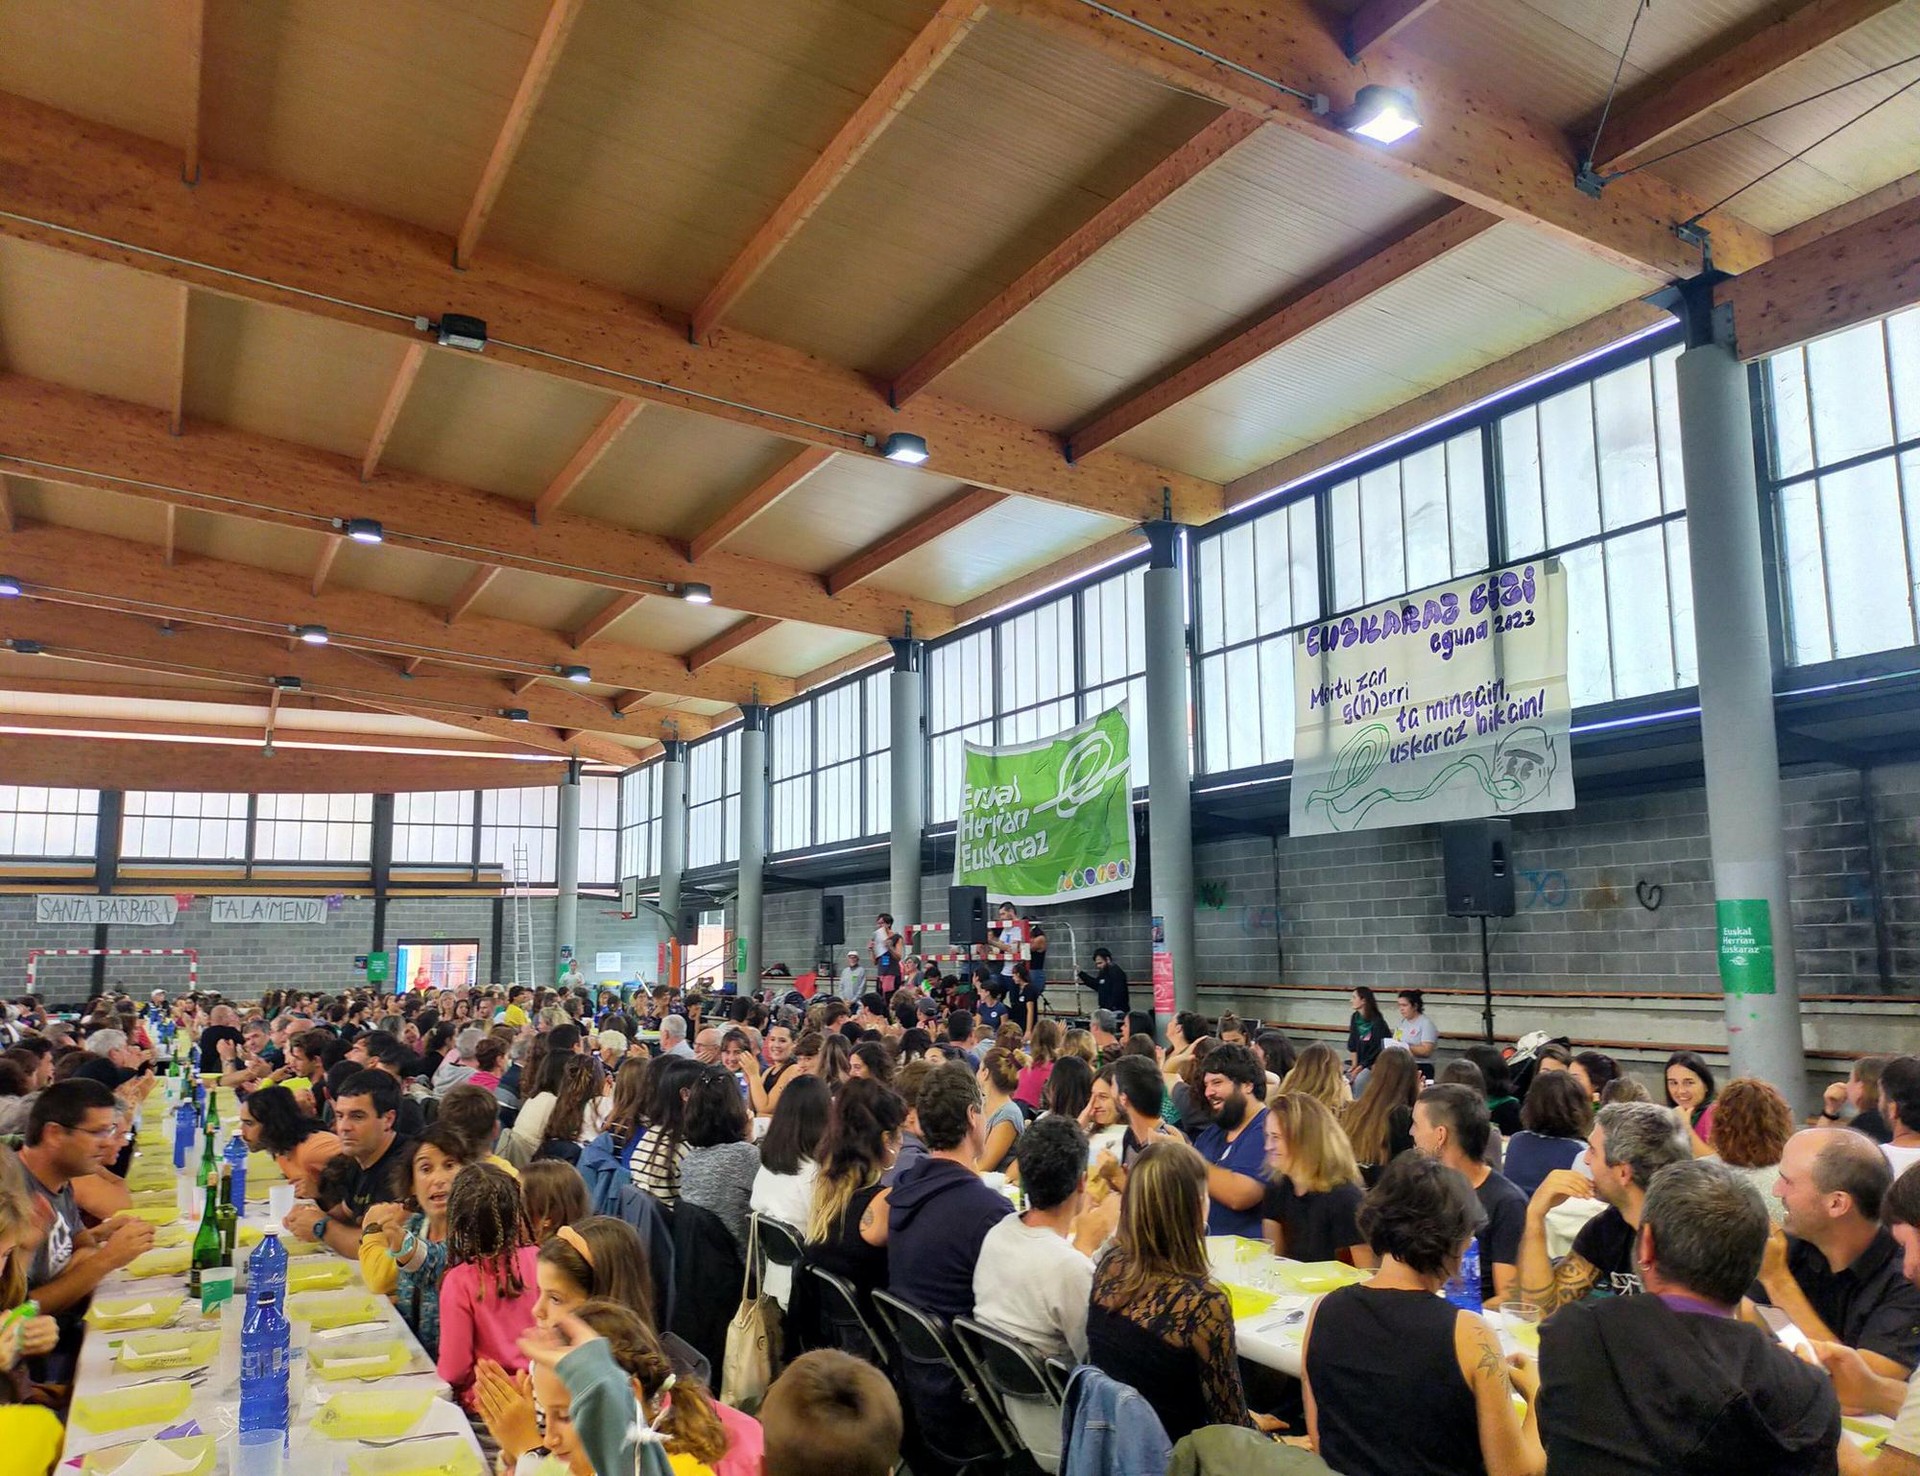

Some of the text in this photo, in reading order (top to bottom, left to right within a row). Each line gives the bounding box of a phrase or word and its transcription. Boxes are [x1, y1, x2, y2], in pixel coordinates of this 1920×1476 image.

[1306, 592, 1461, 658] EUSKARAZ
[1430, 609, 1536, 660] eguna 2023
[1356, 667, 1387, 692] zan
[1343, 681, 1409, 725] g(h)erri
[1476, 688, 1545, 736] bikain!
[1396, 705, 1420, 733] ta
[961, 830, 1049, 873] Euskaraz
[40, 897, 173, 923] SANTA BARBARA
[1722, 926, 1752, 936] Euskal
[1722, 936, 1755, 945] Herrian
[1721, 945, 1760, 954] Euskaraz
